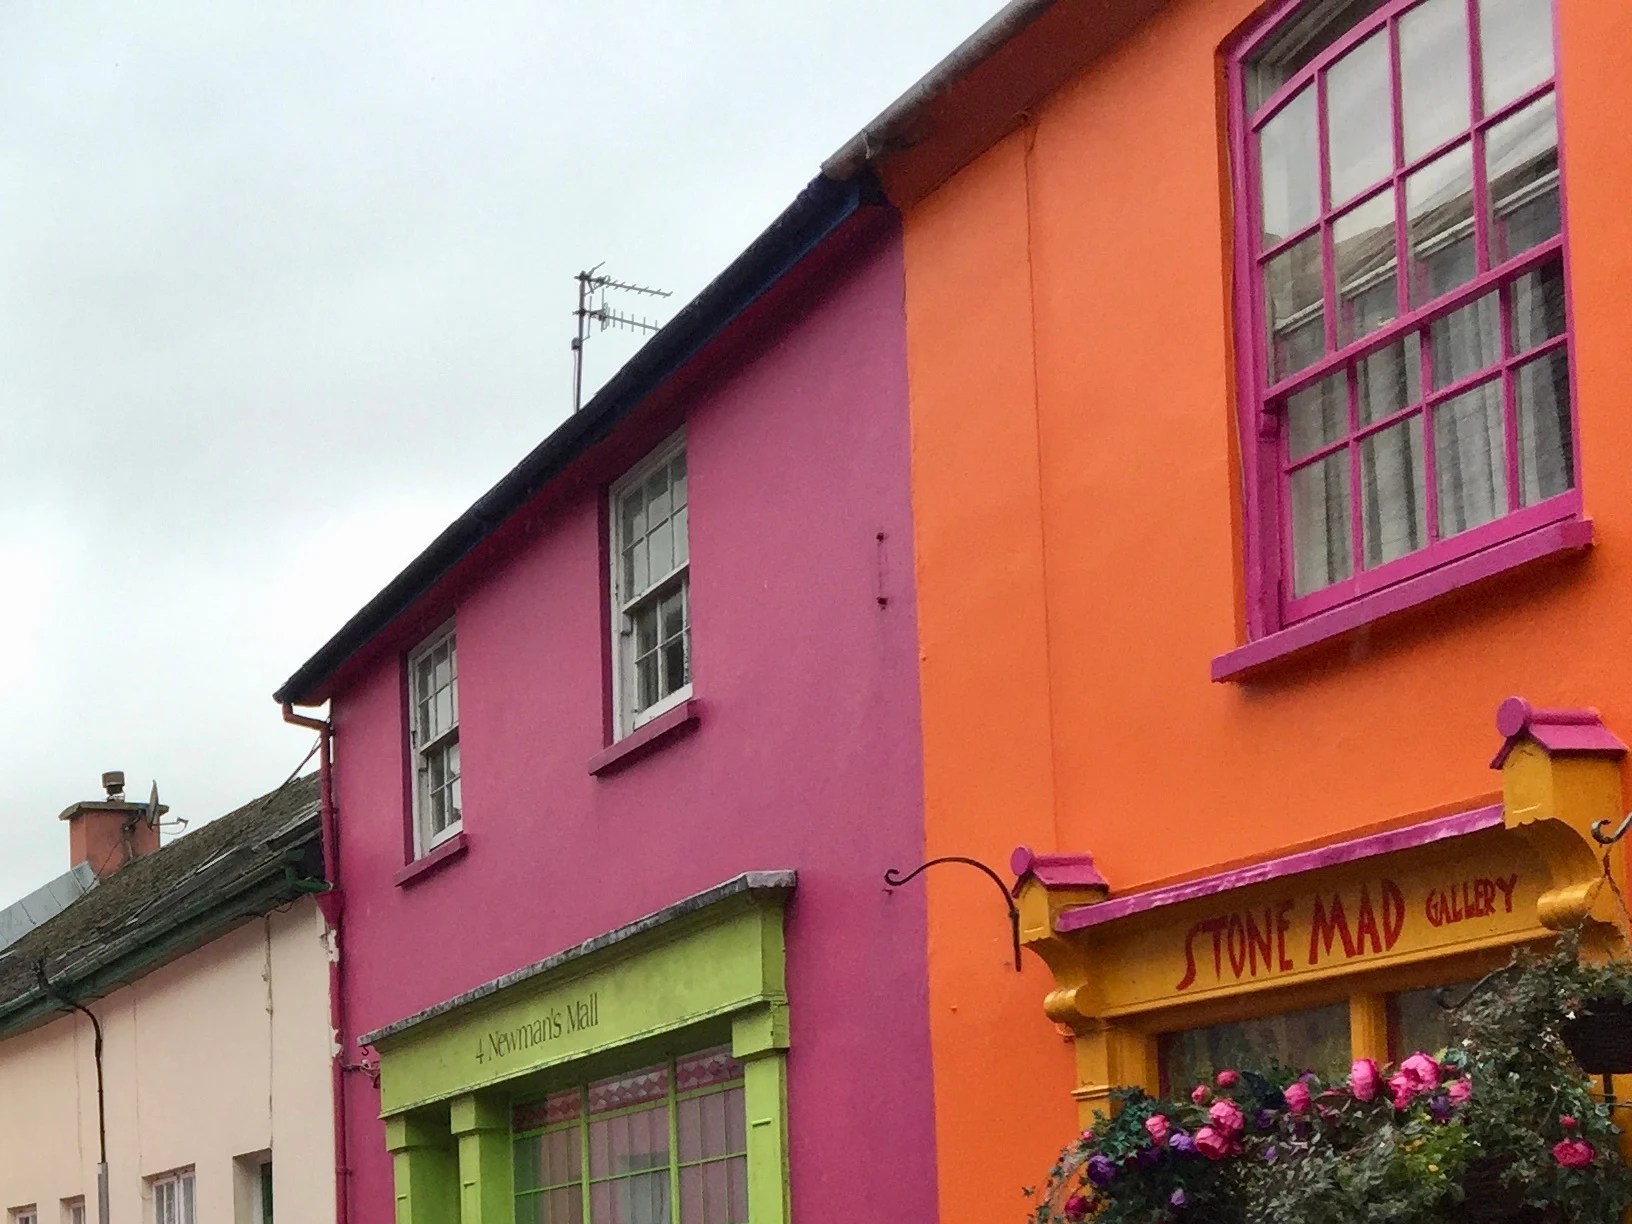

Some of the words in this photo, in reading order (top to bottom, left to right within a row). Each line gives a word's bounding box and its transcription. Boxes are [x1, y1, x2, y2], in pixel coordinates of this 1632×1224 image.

[1176, 902, 1294, 992] STONE
[1308, 878, 1406, 966] MAD
[1425, 872, 1518, 928] GALLERY
[475, 1037, 485, 1065] 4
[488, 1007, 563, 1061] Newman's
[566, 991, 599, 1035] Mall
